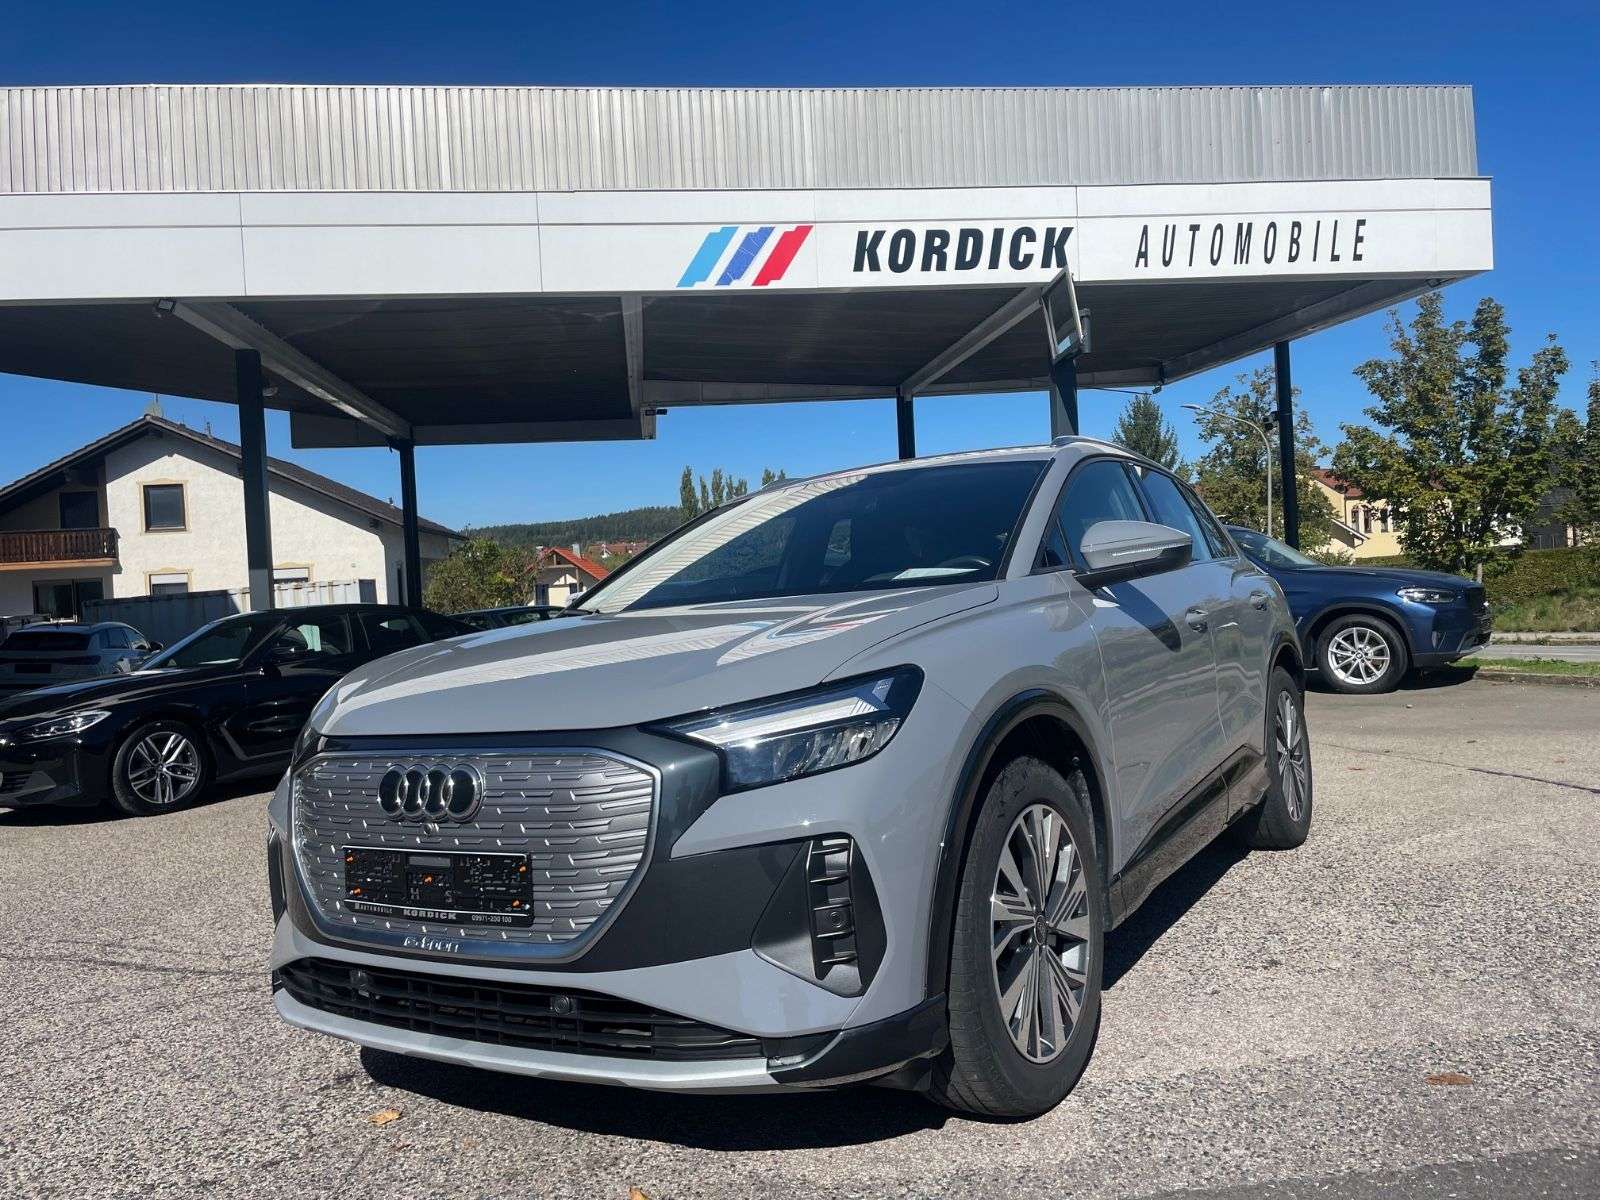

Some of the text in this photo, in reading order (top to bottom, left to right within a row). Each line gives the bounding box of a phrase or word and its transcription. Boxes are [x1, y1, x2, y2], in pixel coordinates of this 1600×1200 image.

[853, 219, 1366, 273] KORDICK AUTOMOBILE
[403, 909, 457, 920] KORDICK
